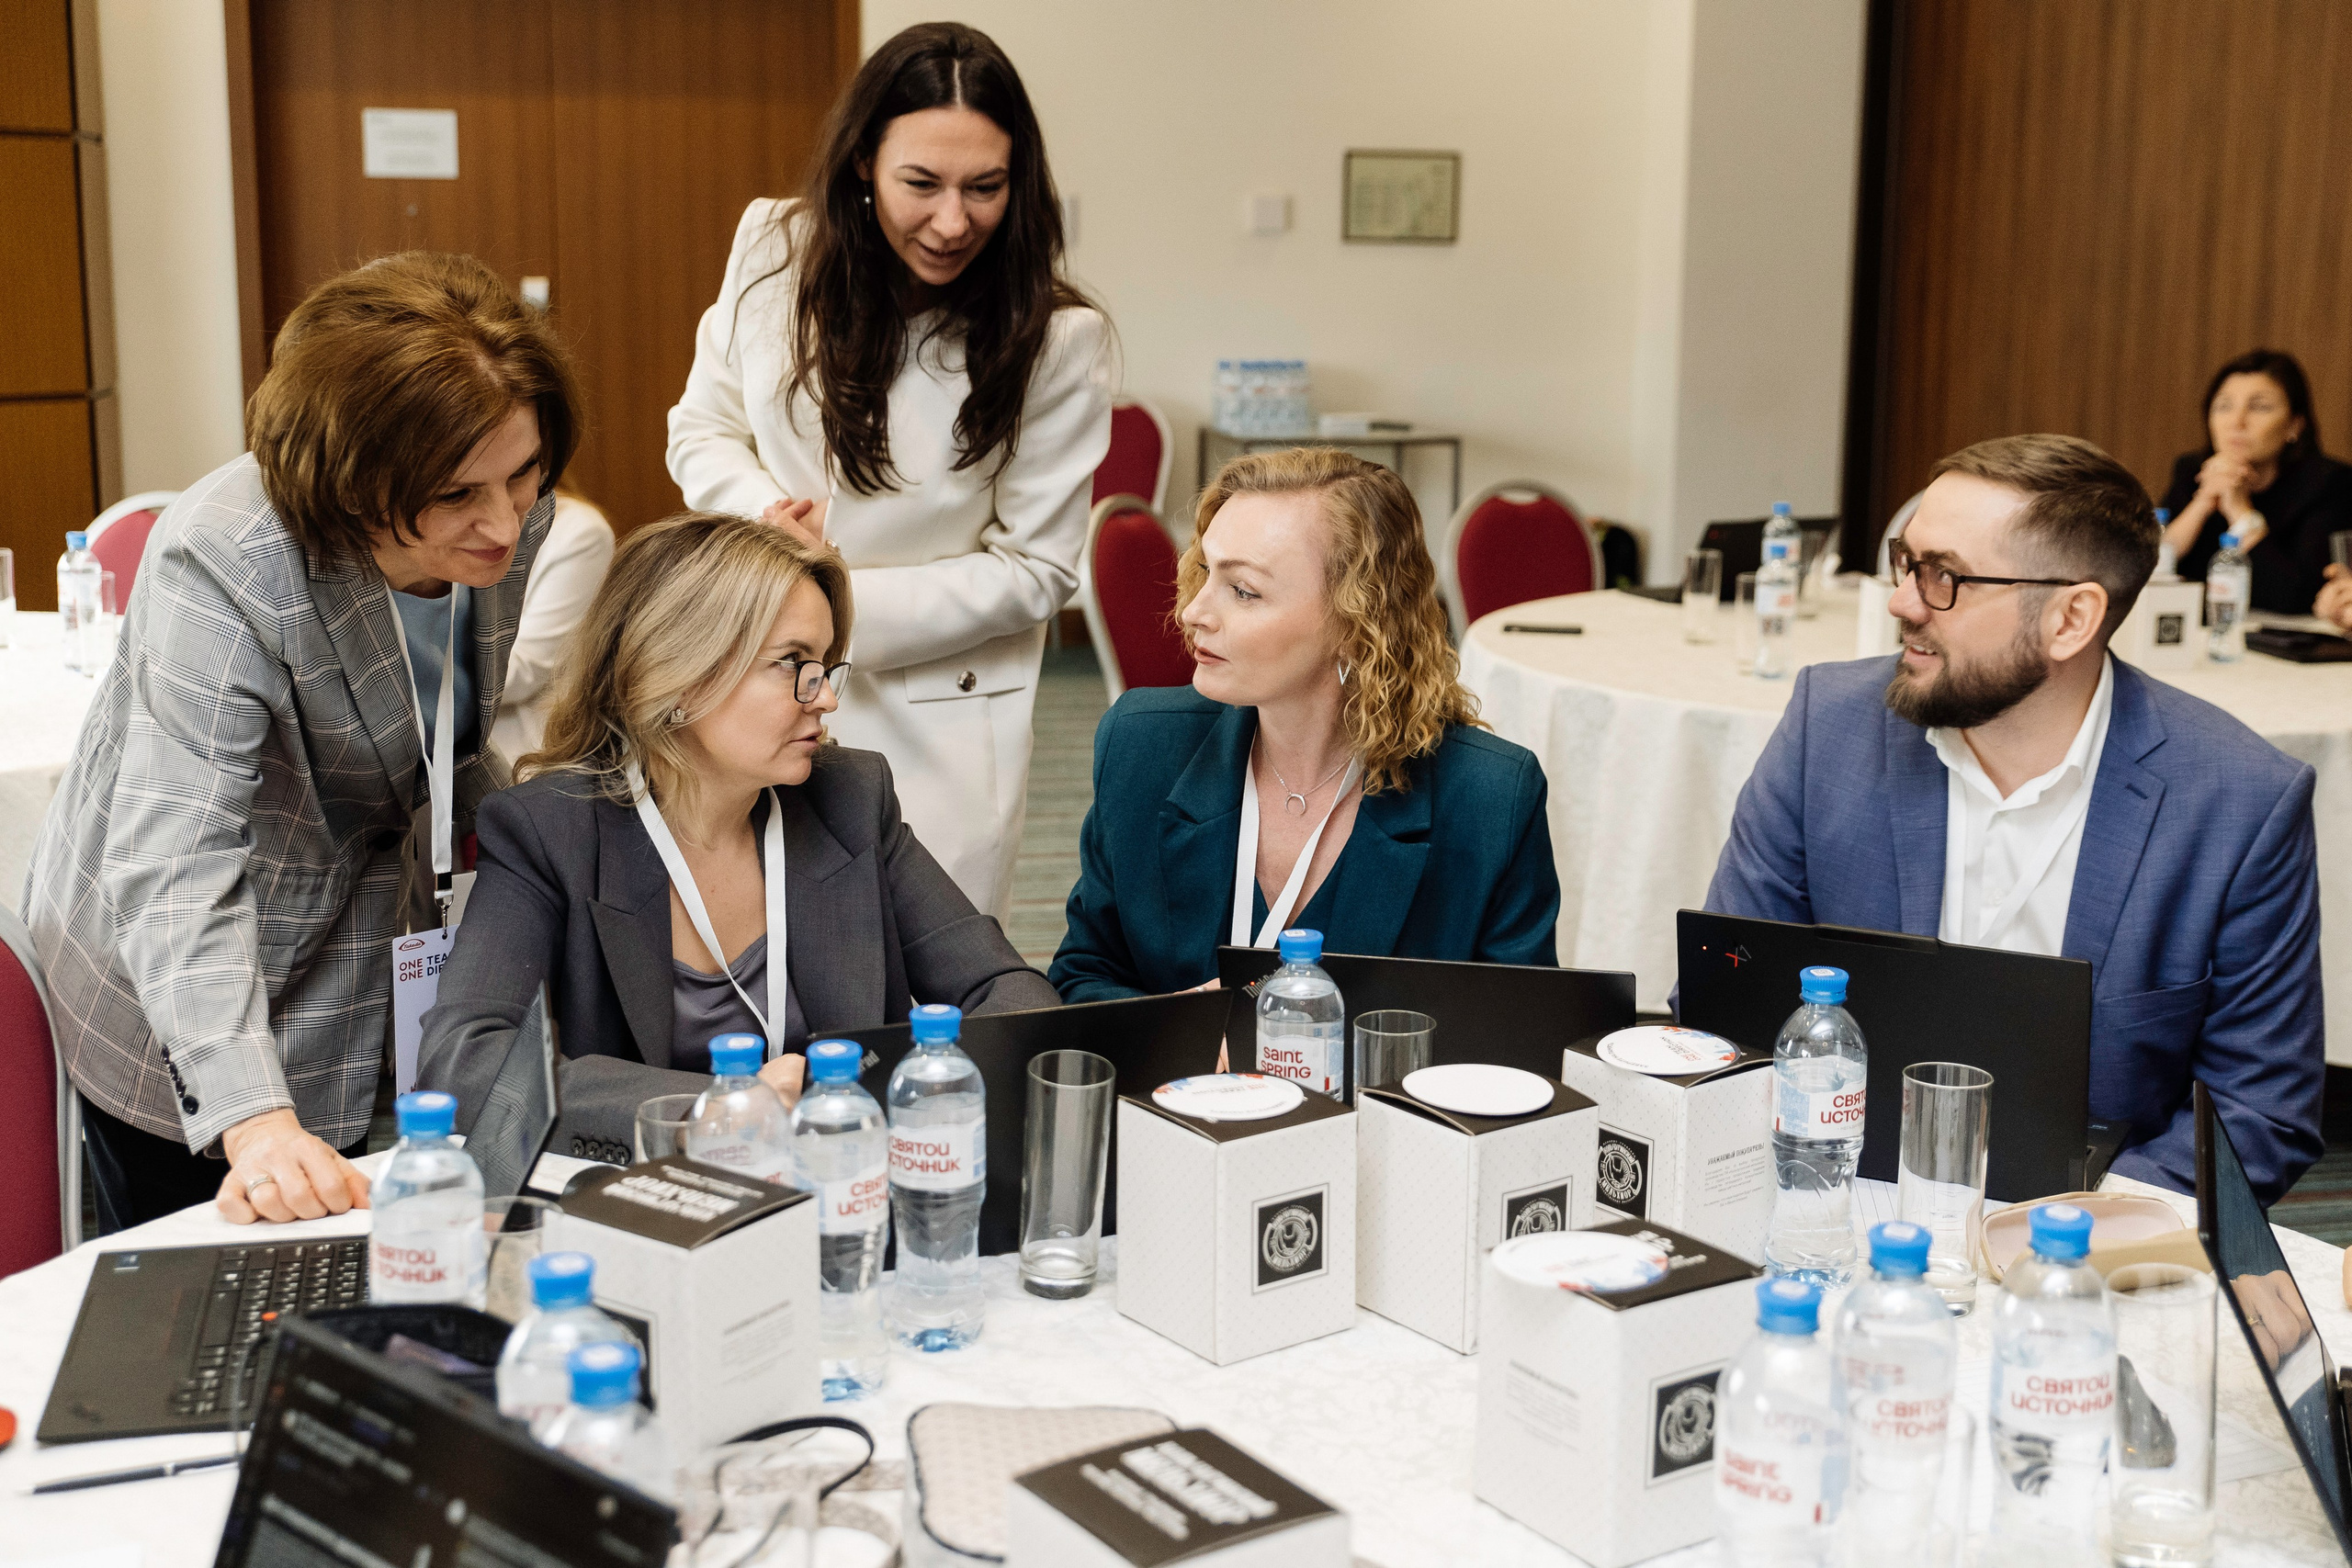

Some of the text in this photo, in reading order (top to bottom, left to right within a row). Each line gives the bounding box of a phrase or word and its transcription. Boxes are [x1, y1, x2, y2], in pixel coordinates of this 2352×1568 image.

[399, 953, 448, 971] ONE TEA
[399, 968, 424, 982] ONE
[1263, 1046, 1303, 1064] Saint
[1261, 1060, 1311, 1078] SPRING
[1820, 1104, 1866, 1124] ИСТОЧ
